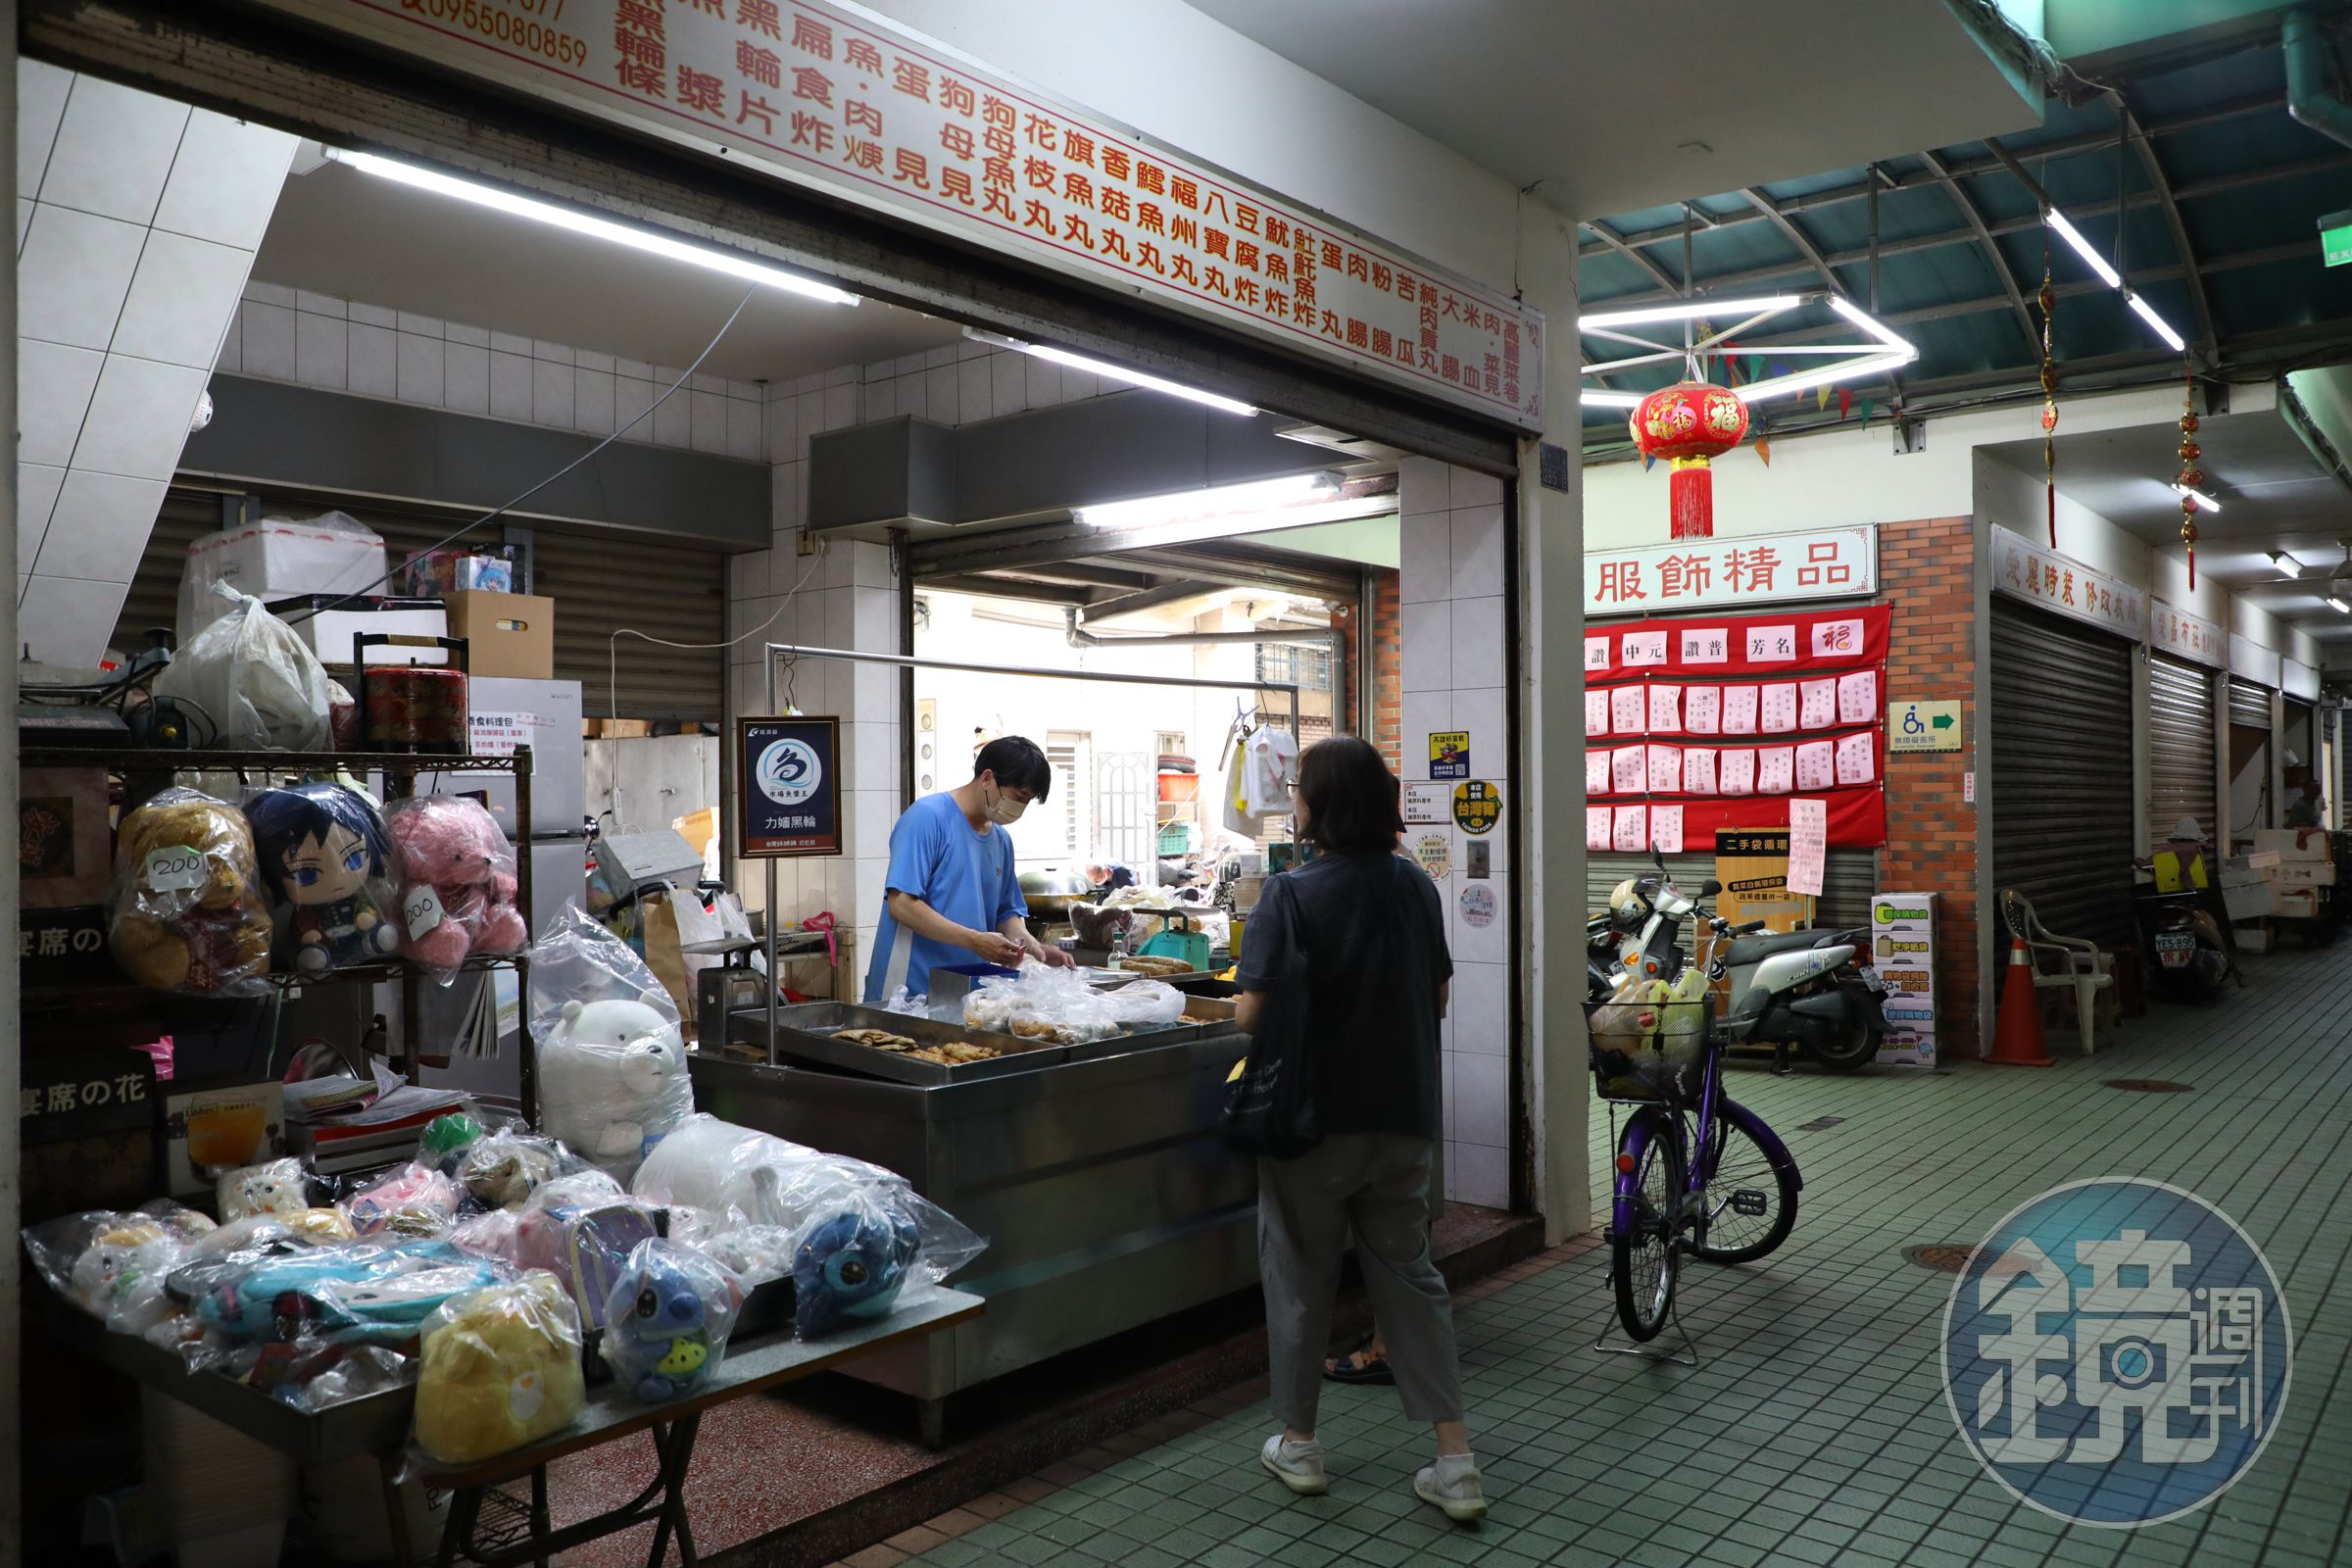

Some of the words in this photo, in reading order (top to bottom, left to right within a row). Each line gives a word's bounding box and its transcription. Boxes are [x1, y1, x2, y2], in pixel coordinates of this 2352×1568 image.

[791, 13, 834, 153] 扁食炸
[939, 74, 975, 206] 狗母見
[982, 92, 1016, 221] 狗母魚丸
[1023, 112, 1056, 236] 花枝丸
[1063, 128, 1095, 250] 旗魚丸
[1101, 145, 1131, 263] 香菇丸
[1137, 161, 1165, 275] 鱈魚丸
[1170, 174, 1198, 287] 福州丸
[1203, 190, 1230, 298] 八寶丸
[1234, 201, 1260, 307] 豆腐炸
[1265, 216, 1290, 318] 魷魚炸
[1594, 541, 1850, 603] 服飾精品
[1626, 643, 1663, 661] 中元
[1685, 640, 1722, 658] 讚普
[1750, 637, 1791, 656] 芳名
[1457, 801, 1495, 816] 台灣豬
[1470, 783, 1482, 792] 本店
[153, 855, 201, 877] 200
[406, 898, 434, 927] 200
